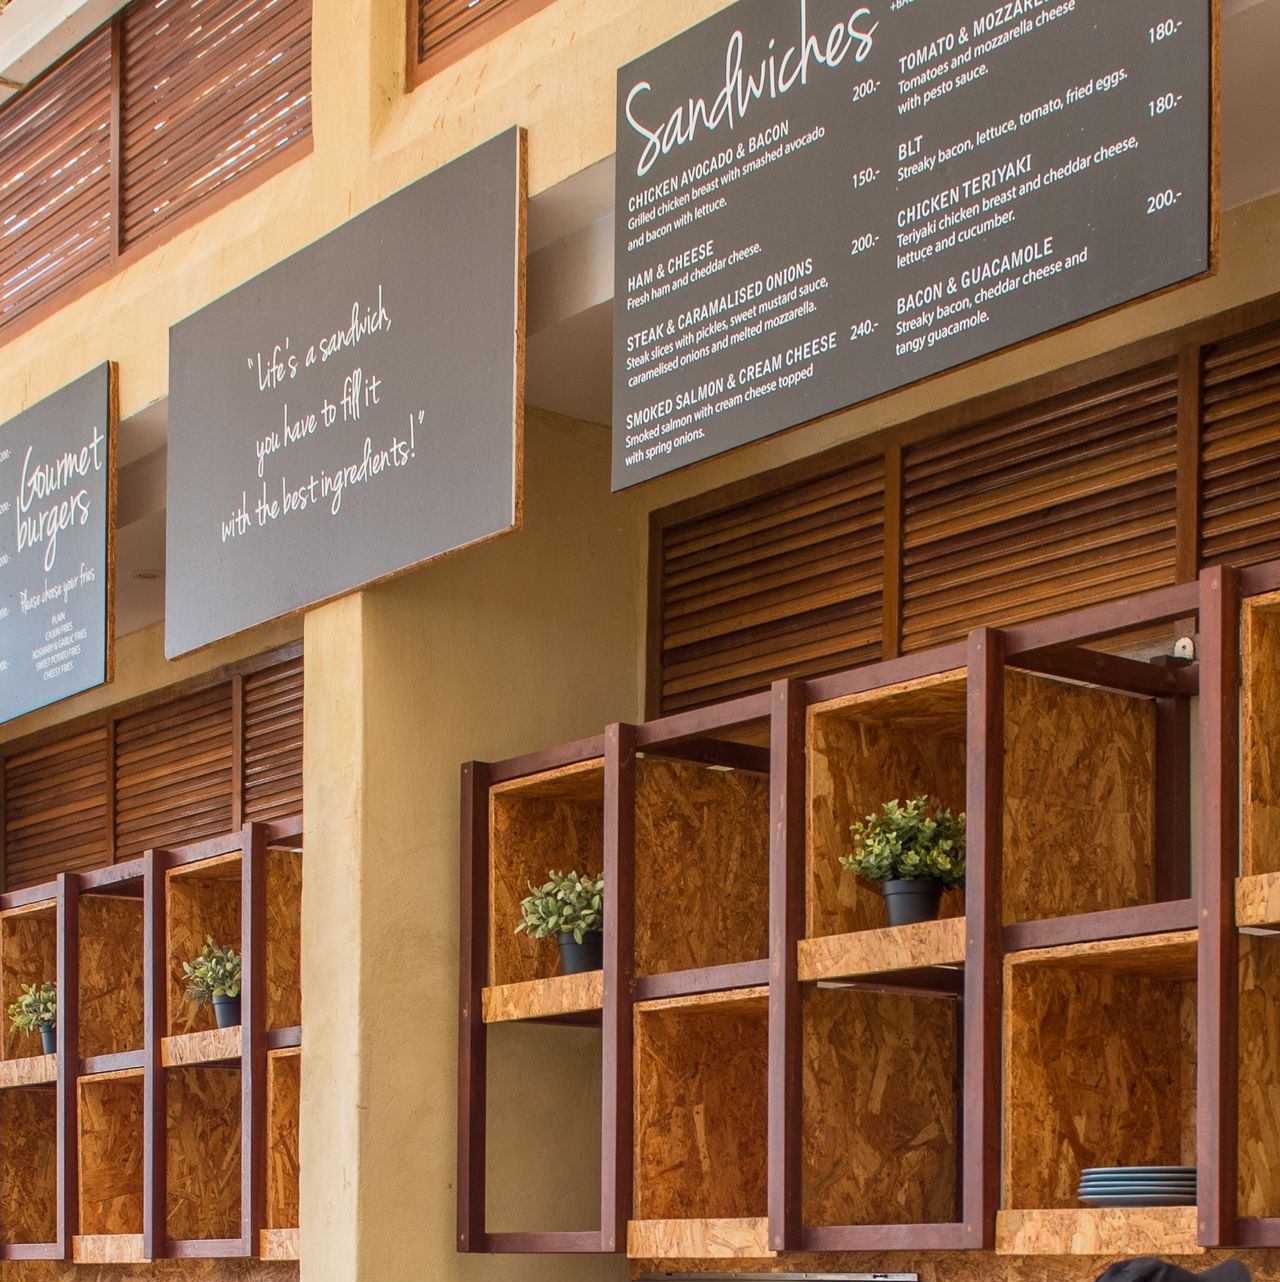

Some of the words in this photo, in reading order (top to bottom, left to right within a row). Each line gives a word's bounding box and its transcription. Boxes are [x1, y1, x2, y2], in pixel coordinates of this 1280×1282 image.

[624, 0, 880, 177] Sandwiches
[897, 62, 949, 95] Tomatoes
[950, 47, 972, 70] and
[973, 20, 1034, 58] mozzarella
[1034, 0, 1076, 27] cheese
[897, 94, 922, 115] with
[923, 81, 954, 107] pesto
[954, 64, 989, 88] sauce.
[898, 34, 955, 74] TOMATO
[957, 28, 969, 45] &
[898, 136, 924, 161] BLT
[1149, 19, 1182, 43] 180.-
[628, 176, 679, 213] CHICKEN
[680, 149, 734, 188] AVOCADO
[735, 143, 746, 160] &
[748, 120, 789, 154] BACON
[853, 79, 880, 101] 200.-
[897, 156, 937, 182] Streaky
[937, 140, 975, 164] bacon,
[976, 120, 1018, 146] lettuce,
[1018, 99, 1064, 126] tomato,
[1065, 80, 1094, 105] fried
[1095, 69, 1128, 92] eggs.
[897, 187, 960, 228] CHICKEN
[961, 156, 1032, 199] TERIYAKI
[1149, 93, 1182, 116] 180.-
[627, 207, 656, 231] Grilled
[656, 194, 690, 217] chicken
[691, 177, 719, 200] breast
[720, 167, 741, 186] with
[742, 145, 783, 176] smashed
[784, 127, 826, 155] avocado
[896, 220, 937, 248] Teriyaki
[938, 204, 980, 231] chicken
[982, 186, 1017, 212] breast
[1018, 175, 1041, 196] and
[1042, 155, 1092, 185] cheddar
[1093, 137, 1139, 164] cheese,
[627, 233, 645, 252] and
[645, 223, 673, 243] bacon
[673, 211, 693, 230] with
[694, 198, 728, 220] lettuce.
[627, 268, 654, 293] HAM
[656, 264, 666, 280] &
[667, 240, 714, 274] CHEESE
[853, 168, 880, 188] 150.-
[896, 245, 934, 269] lettuce
[934, 232, 956, 253] and
[957, 210, 1016, 243] cucumber.
[896, 283, 943, 315] BACON
[946, 278, 958, 295] &
[960, 239, 1054, 289] GUACAMOLE
[1147, 189, 1181, 214] 200.-
[626, 323, 664, 352] STEAK
[666, 320, 676, 336] &
[677, 281, 764, 330] CARAMALISED
[765, 259, 813, 292] ONIONS
[851, 234, 879, 255] 200.-
[627, 291, 650, 311] Fresh
[651, 284, 671, 301] ham
[671, 272, 689, 291] and
[689, 258, 727, 283] cheddar
[727, 244, 762, 266] cheese.
[895, 312, 935, 336] Streaky
[936, 298, 973, 320] bacon,
[974, 277, 1021, 305] cheddar
[1022, 261, 1063, 286] cheese
[1064, 248, 1088, 269] and
[305, 345, 316, 368] a
[319, 284, 392, 362] sandwich,
[626, 351, 650, 371] Steak
[650, 343, 674, 361] slices
[674, 332, 695, 350] with
[695, 320, 729, 345] pickles,
[729, 305, 757, 327] sweet
[758, 286, 798, 315] mustard
[798, 277, 829, 298] sauce,
[627, 356, 679, 388] caramelised
[679, 346, 711, 367] onions
[710, 335, 729, 354] and
[730, 320, 763, 346] melted
[764, 300, 817, 332] mozzarella.
[895, 336, 927, 356] tangy
[927, 311, 990, 347] guacamole.
[625, 424, 660, 449] Smoked
[661, 415, 693, 435] salmon
[693, 404, 714, 422] with
[714, 394, 743, 413] cream
[744, 381, 777, 402] cheese
[778, 363, 814, 389] topped
[626, 399, 674, 430] SMOKED
[675, 378, 724, 410] SALMON
[726, 374, 737, 390] &
[738, 354, 782, 385] CREAM
[785, 332, 837, 366] CHEESE
[851, 320, 878, 340] 240.-
[256, 431, 281, 478] you
[284, 403, 317, 447] have
[321, 399, 337, 428] to
[340, 367, 362, 421] fill
[365, 375, 382, 407] it
[624, 449, 645, 467] with
[645, 441, 673, 461] spring
[673, 428, 706, 448] onions.
[21, 426, 104, 513] Gourmet
[221, 491, 251, 543] with
[255, 481, 280, 527] the
[282, 476, 319, 515] best
[16, 489, 91, 572] burgers
[20, 589, 40, 615] Please
[42, 578, 62, 603] choose
[63, 576, 79, 604] your
[79, 562, 96, 587] fries
